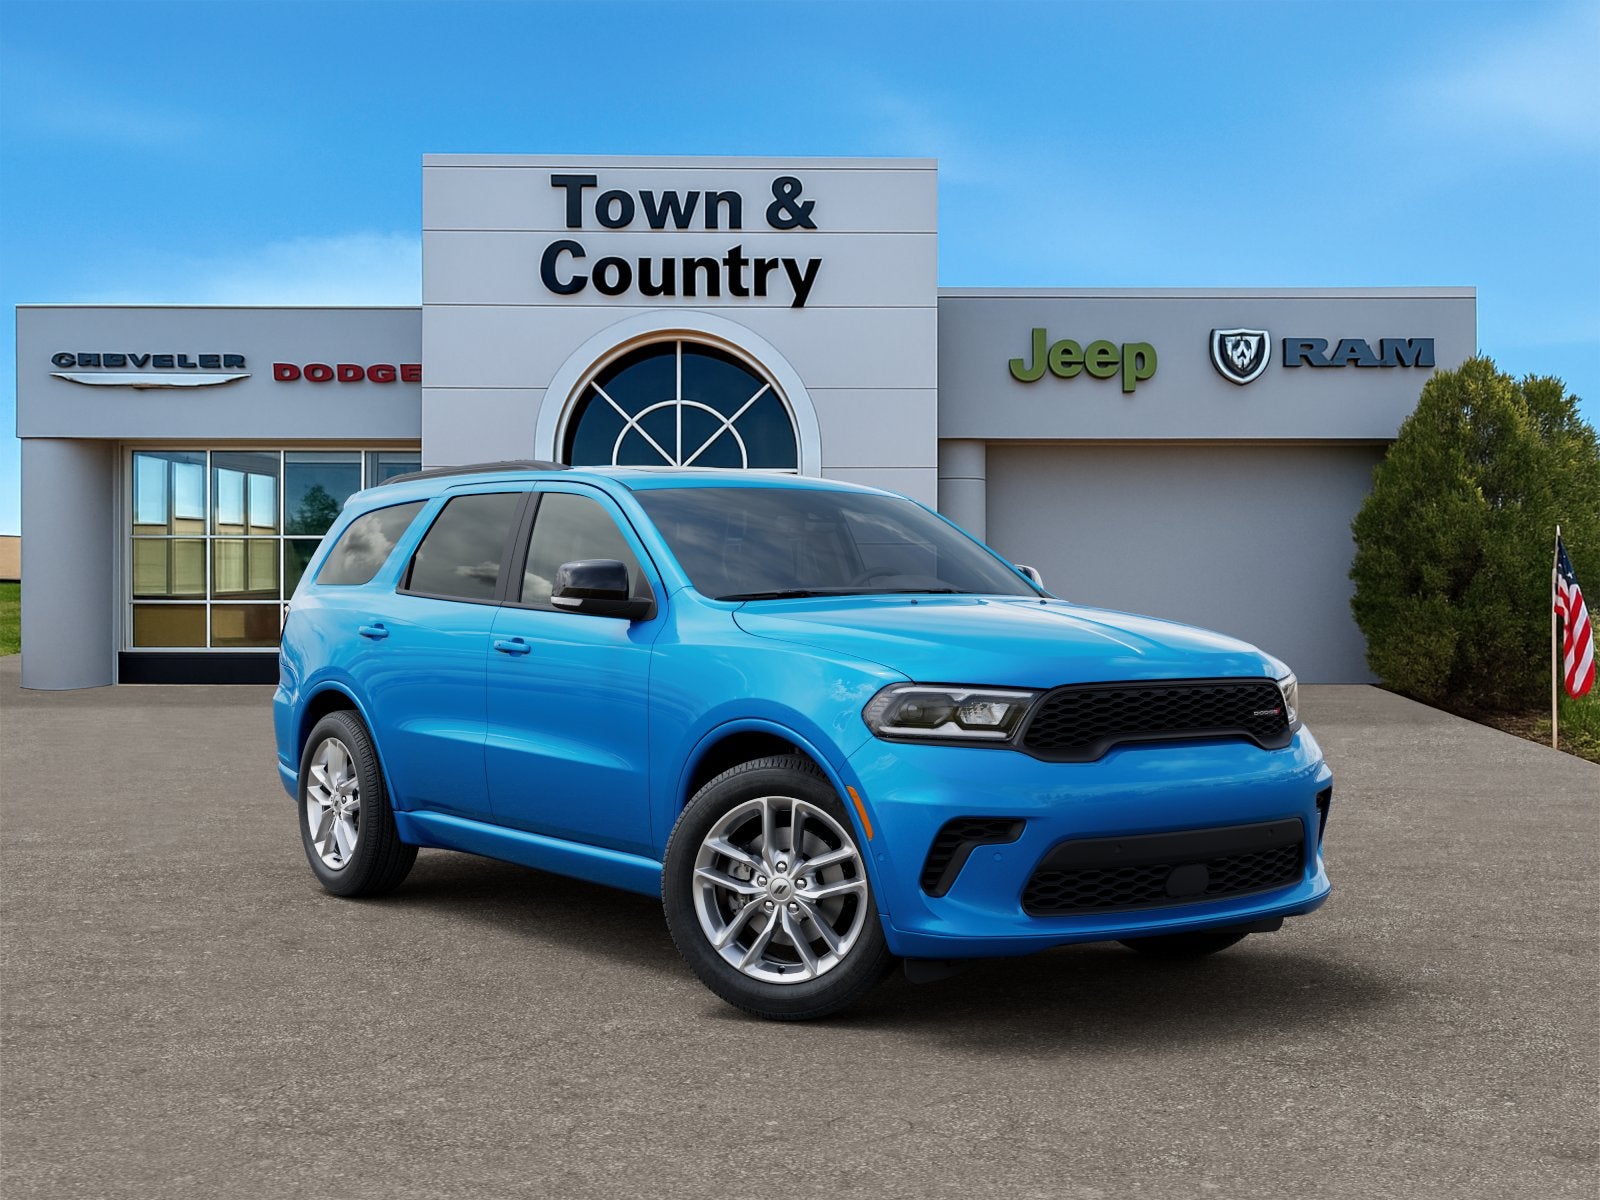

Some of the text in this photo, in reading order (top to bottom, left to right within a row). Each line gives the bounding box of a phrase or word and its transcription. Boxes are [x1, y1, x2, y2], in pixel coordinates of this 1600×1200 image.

[550, 174, 818, 230] Town &
[540, 239, 822, 308] Country
[273, 363, 422, 383] DODGE
[1009, 328, 1157, 393] Jeep
[1282, 338, 1435, 367] RAM
